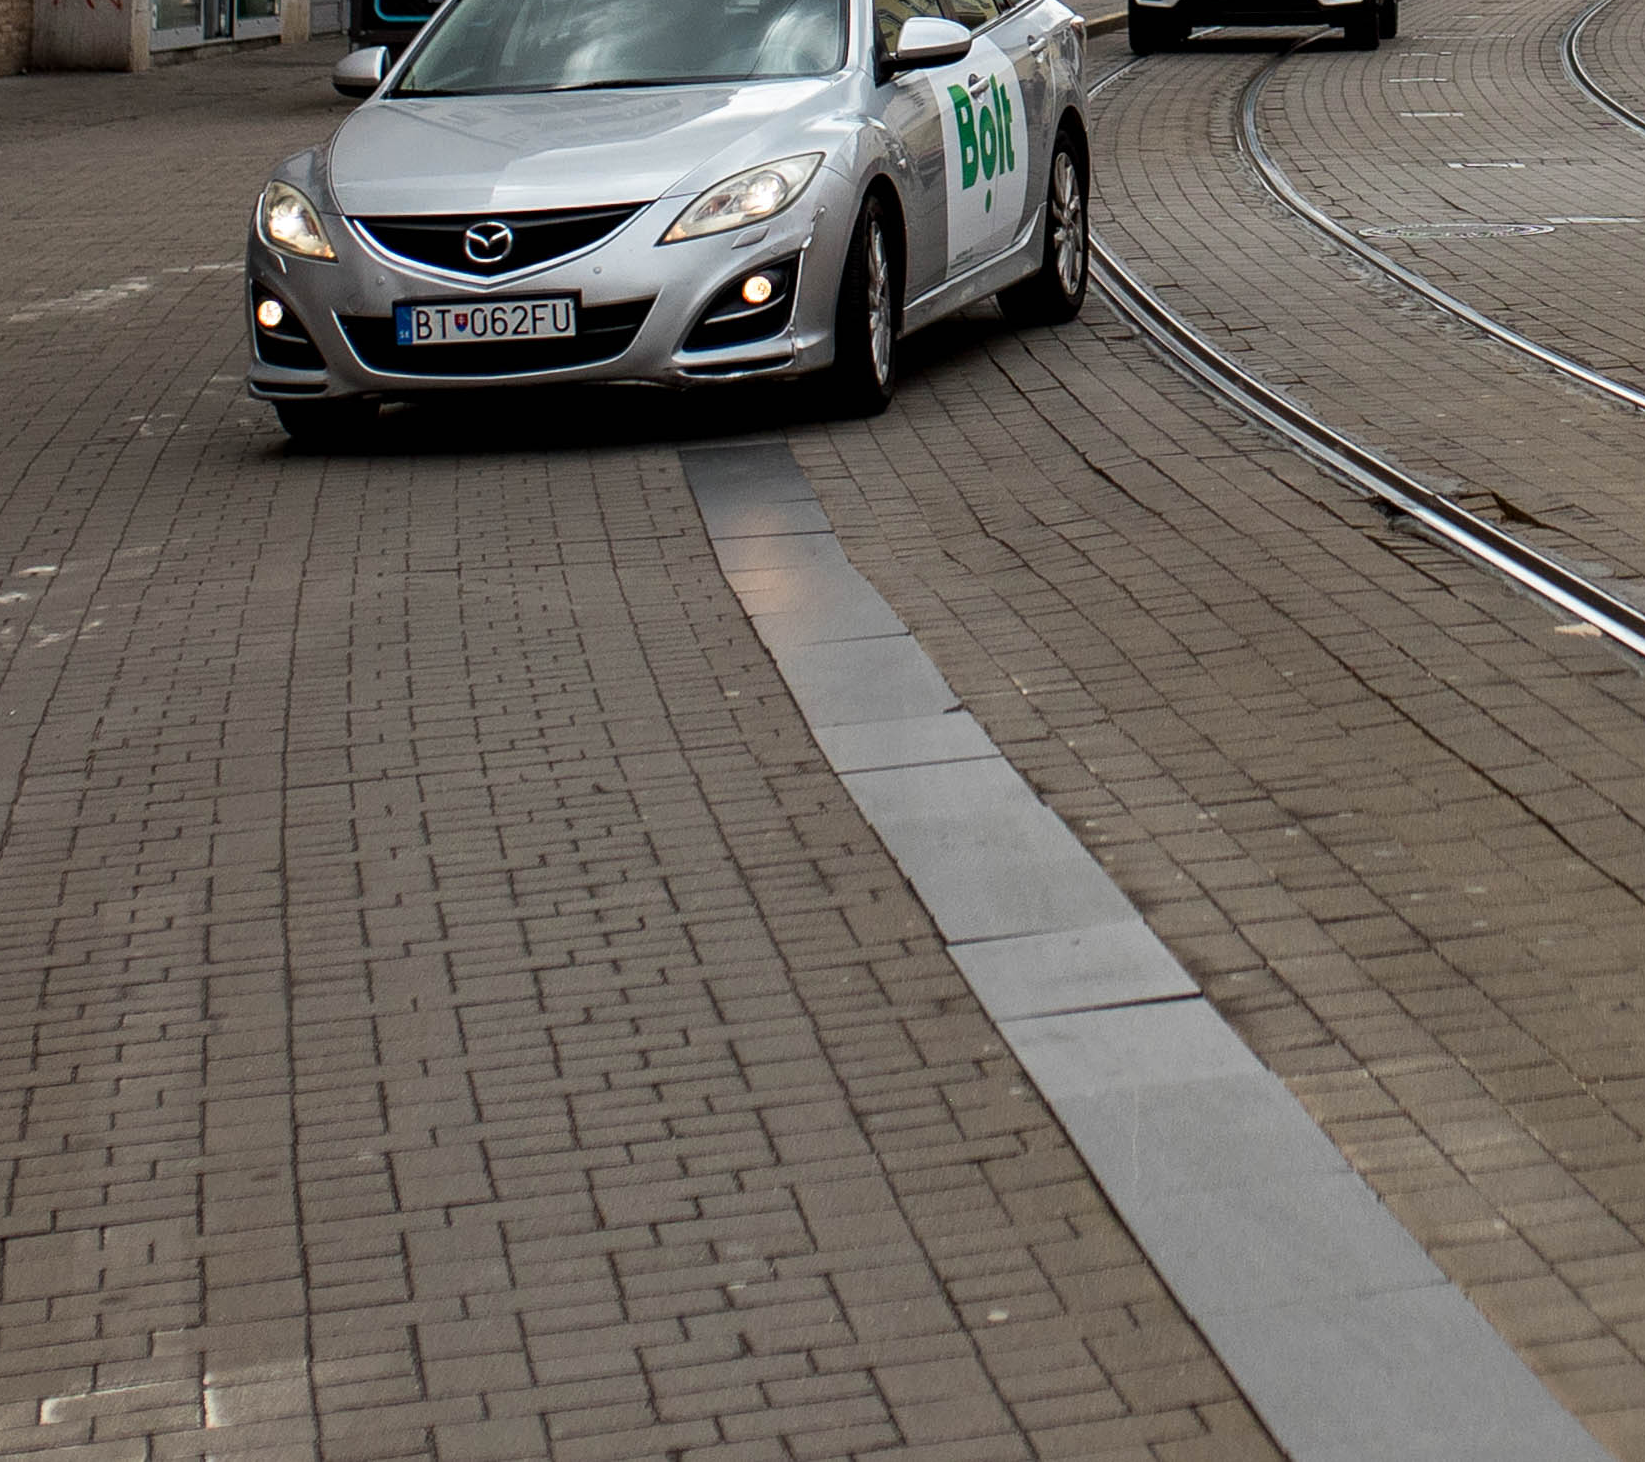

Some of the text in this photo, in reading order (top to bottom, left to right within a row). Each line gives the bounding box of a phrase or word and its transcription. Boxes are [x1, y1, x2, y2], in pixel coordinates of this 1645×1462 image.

[947, 73, 1015, 191] Bolt
[415, 302, 572, 341] BT 062FU
